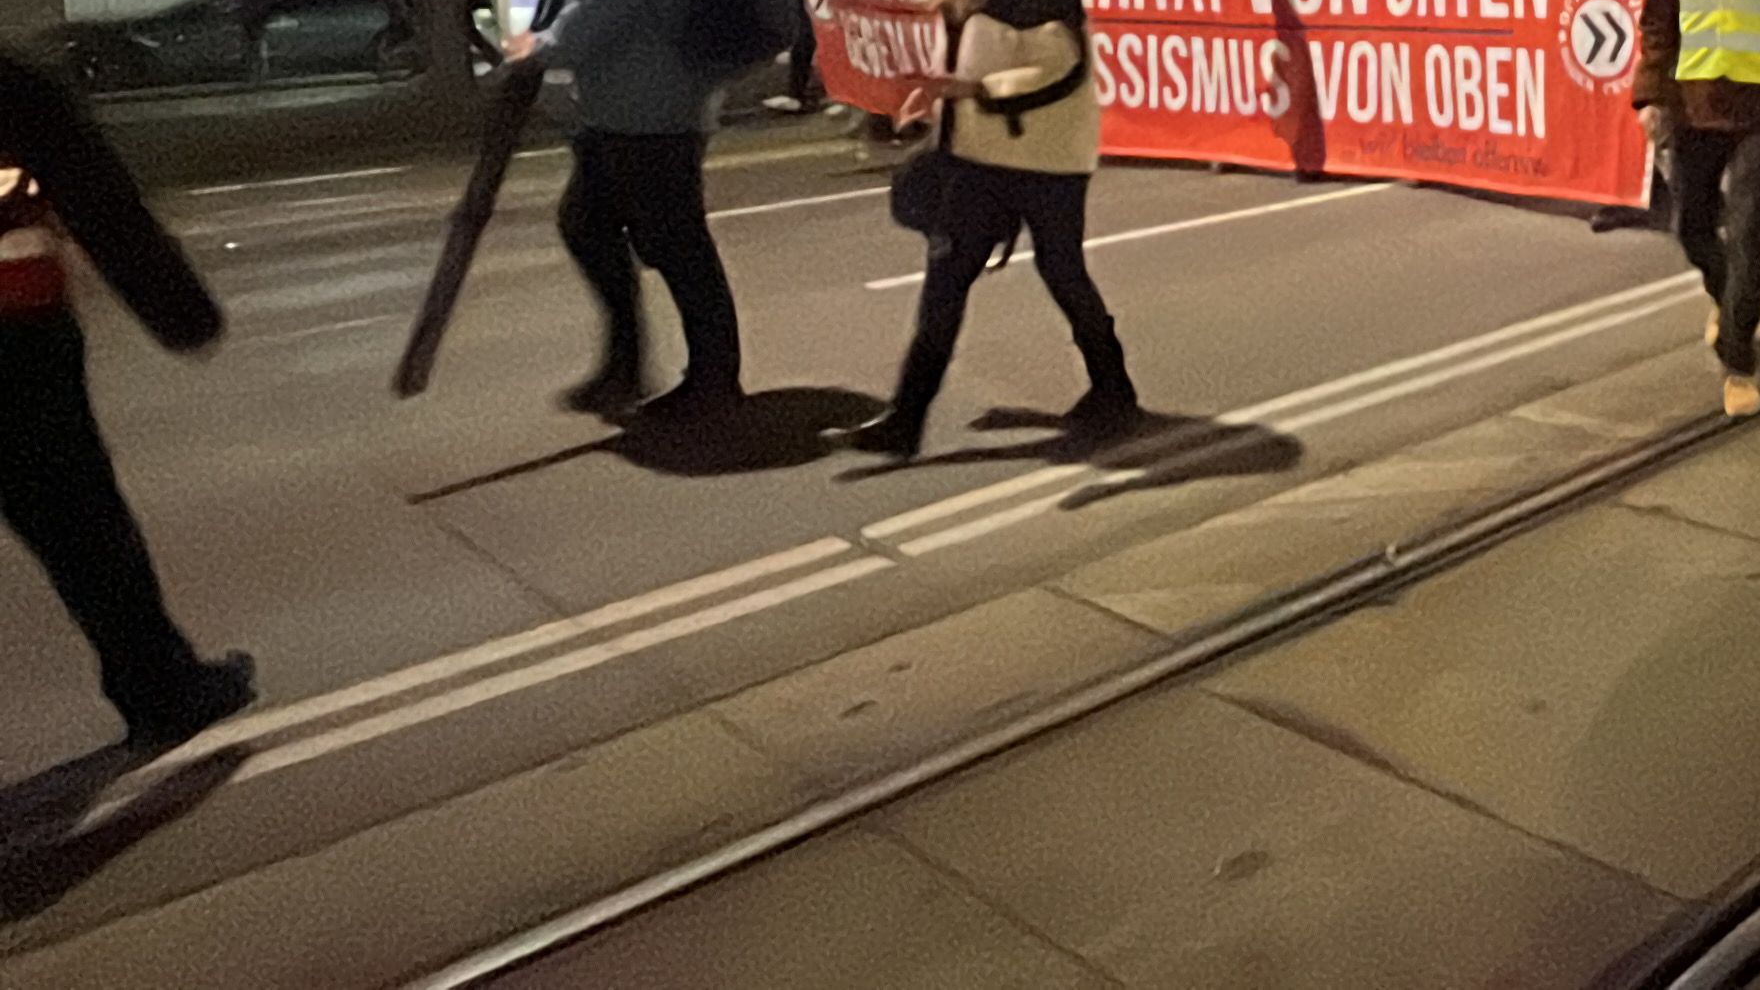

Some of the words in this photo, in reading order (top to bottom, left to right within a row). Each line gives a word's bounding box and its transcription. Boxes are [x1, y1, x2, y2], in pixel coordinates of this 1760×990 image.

[1092, 32, 1291, 120] SSISMUS
[1309, 38, 1415, 125] VON
[1424, 44, 1546, 139] OBEN
